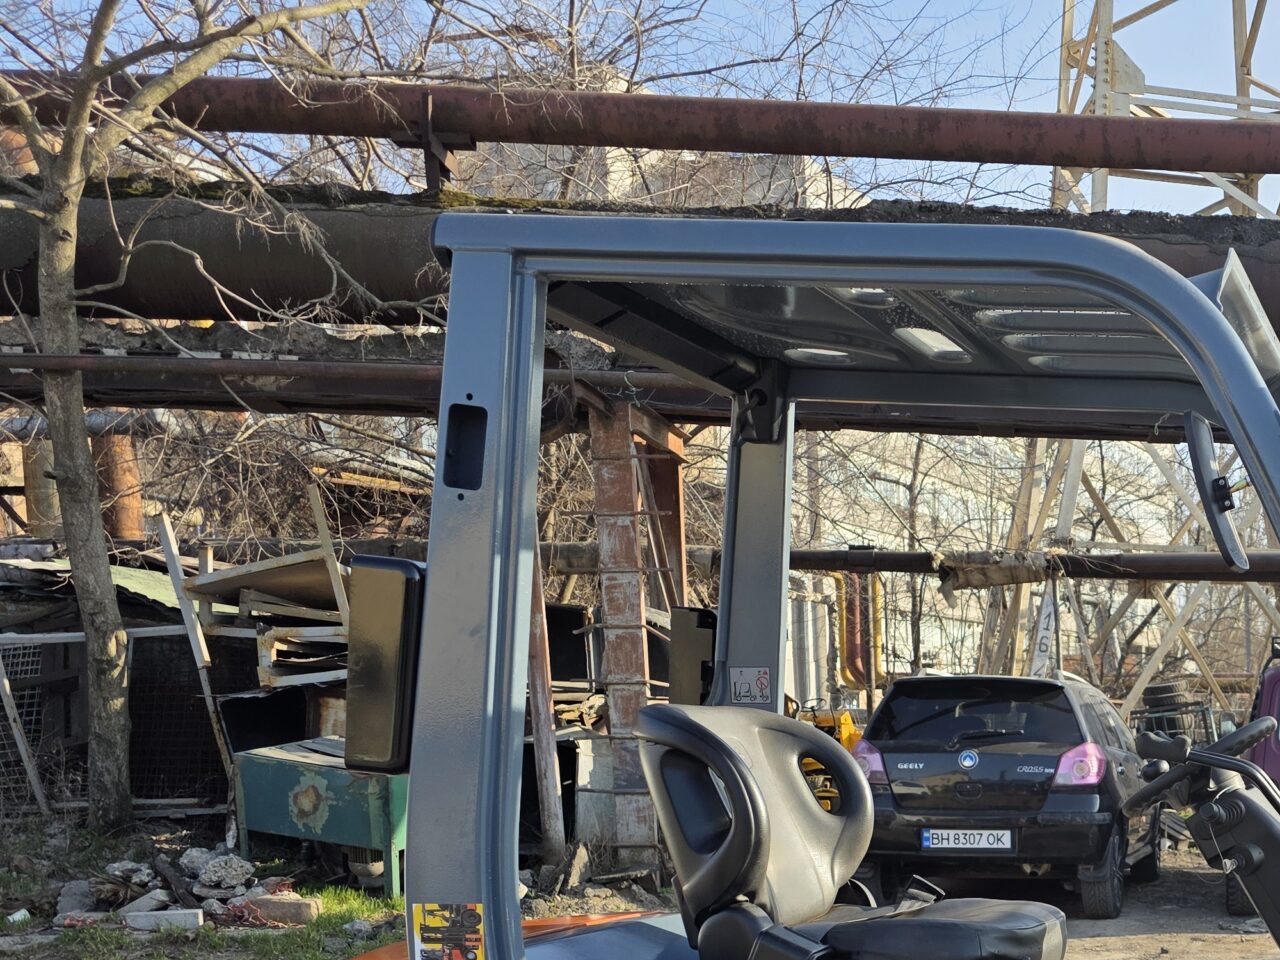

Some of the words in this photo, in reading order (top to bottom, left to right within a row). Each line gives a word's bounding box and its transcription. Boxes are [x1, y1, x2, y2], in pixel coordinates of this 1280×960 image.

[897, 762, 925, 770] GEELY
[931, 833, 950, 846] BH
[953, 833, 983, 846] 8307
[986, 833, 1006, 846] OK
